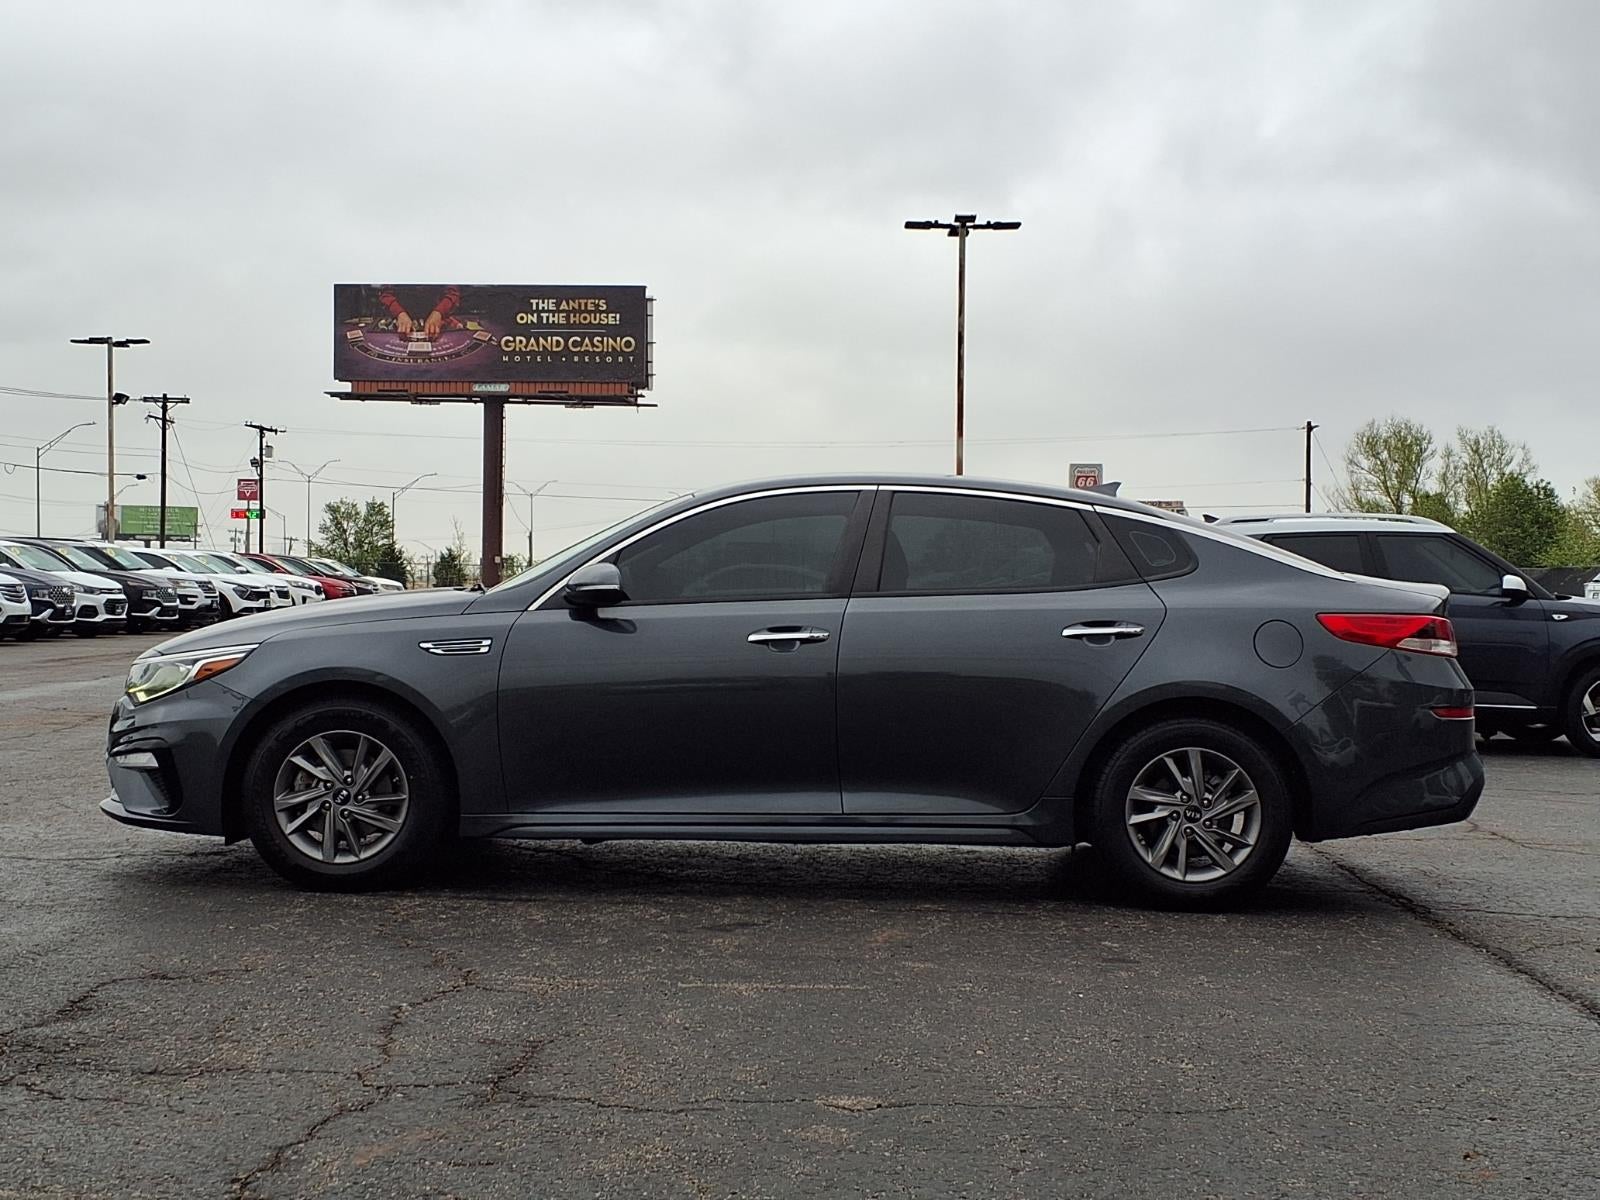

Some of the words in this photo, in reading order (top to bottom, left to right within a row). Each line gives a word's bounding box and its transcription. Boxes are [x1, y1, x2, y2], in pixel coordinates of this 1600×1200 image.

[530, 299, 556, 310] THE
[559, 299, 607, 311] ANTE'S
[516, 313, 537, 324] ON
[541, 313, 567, 324] THE
[570, 313, 620, 324] HOUSE!
[500, 336, 564, 352] GRAND
[568, 336, 636, 352] CASINO
[1077, 477, 1095, 487] 66
[1185, 809, 1201, 819] KIA
